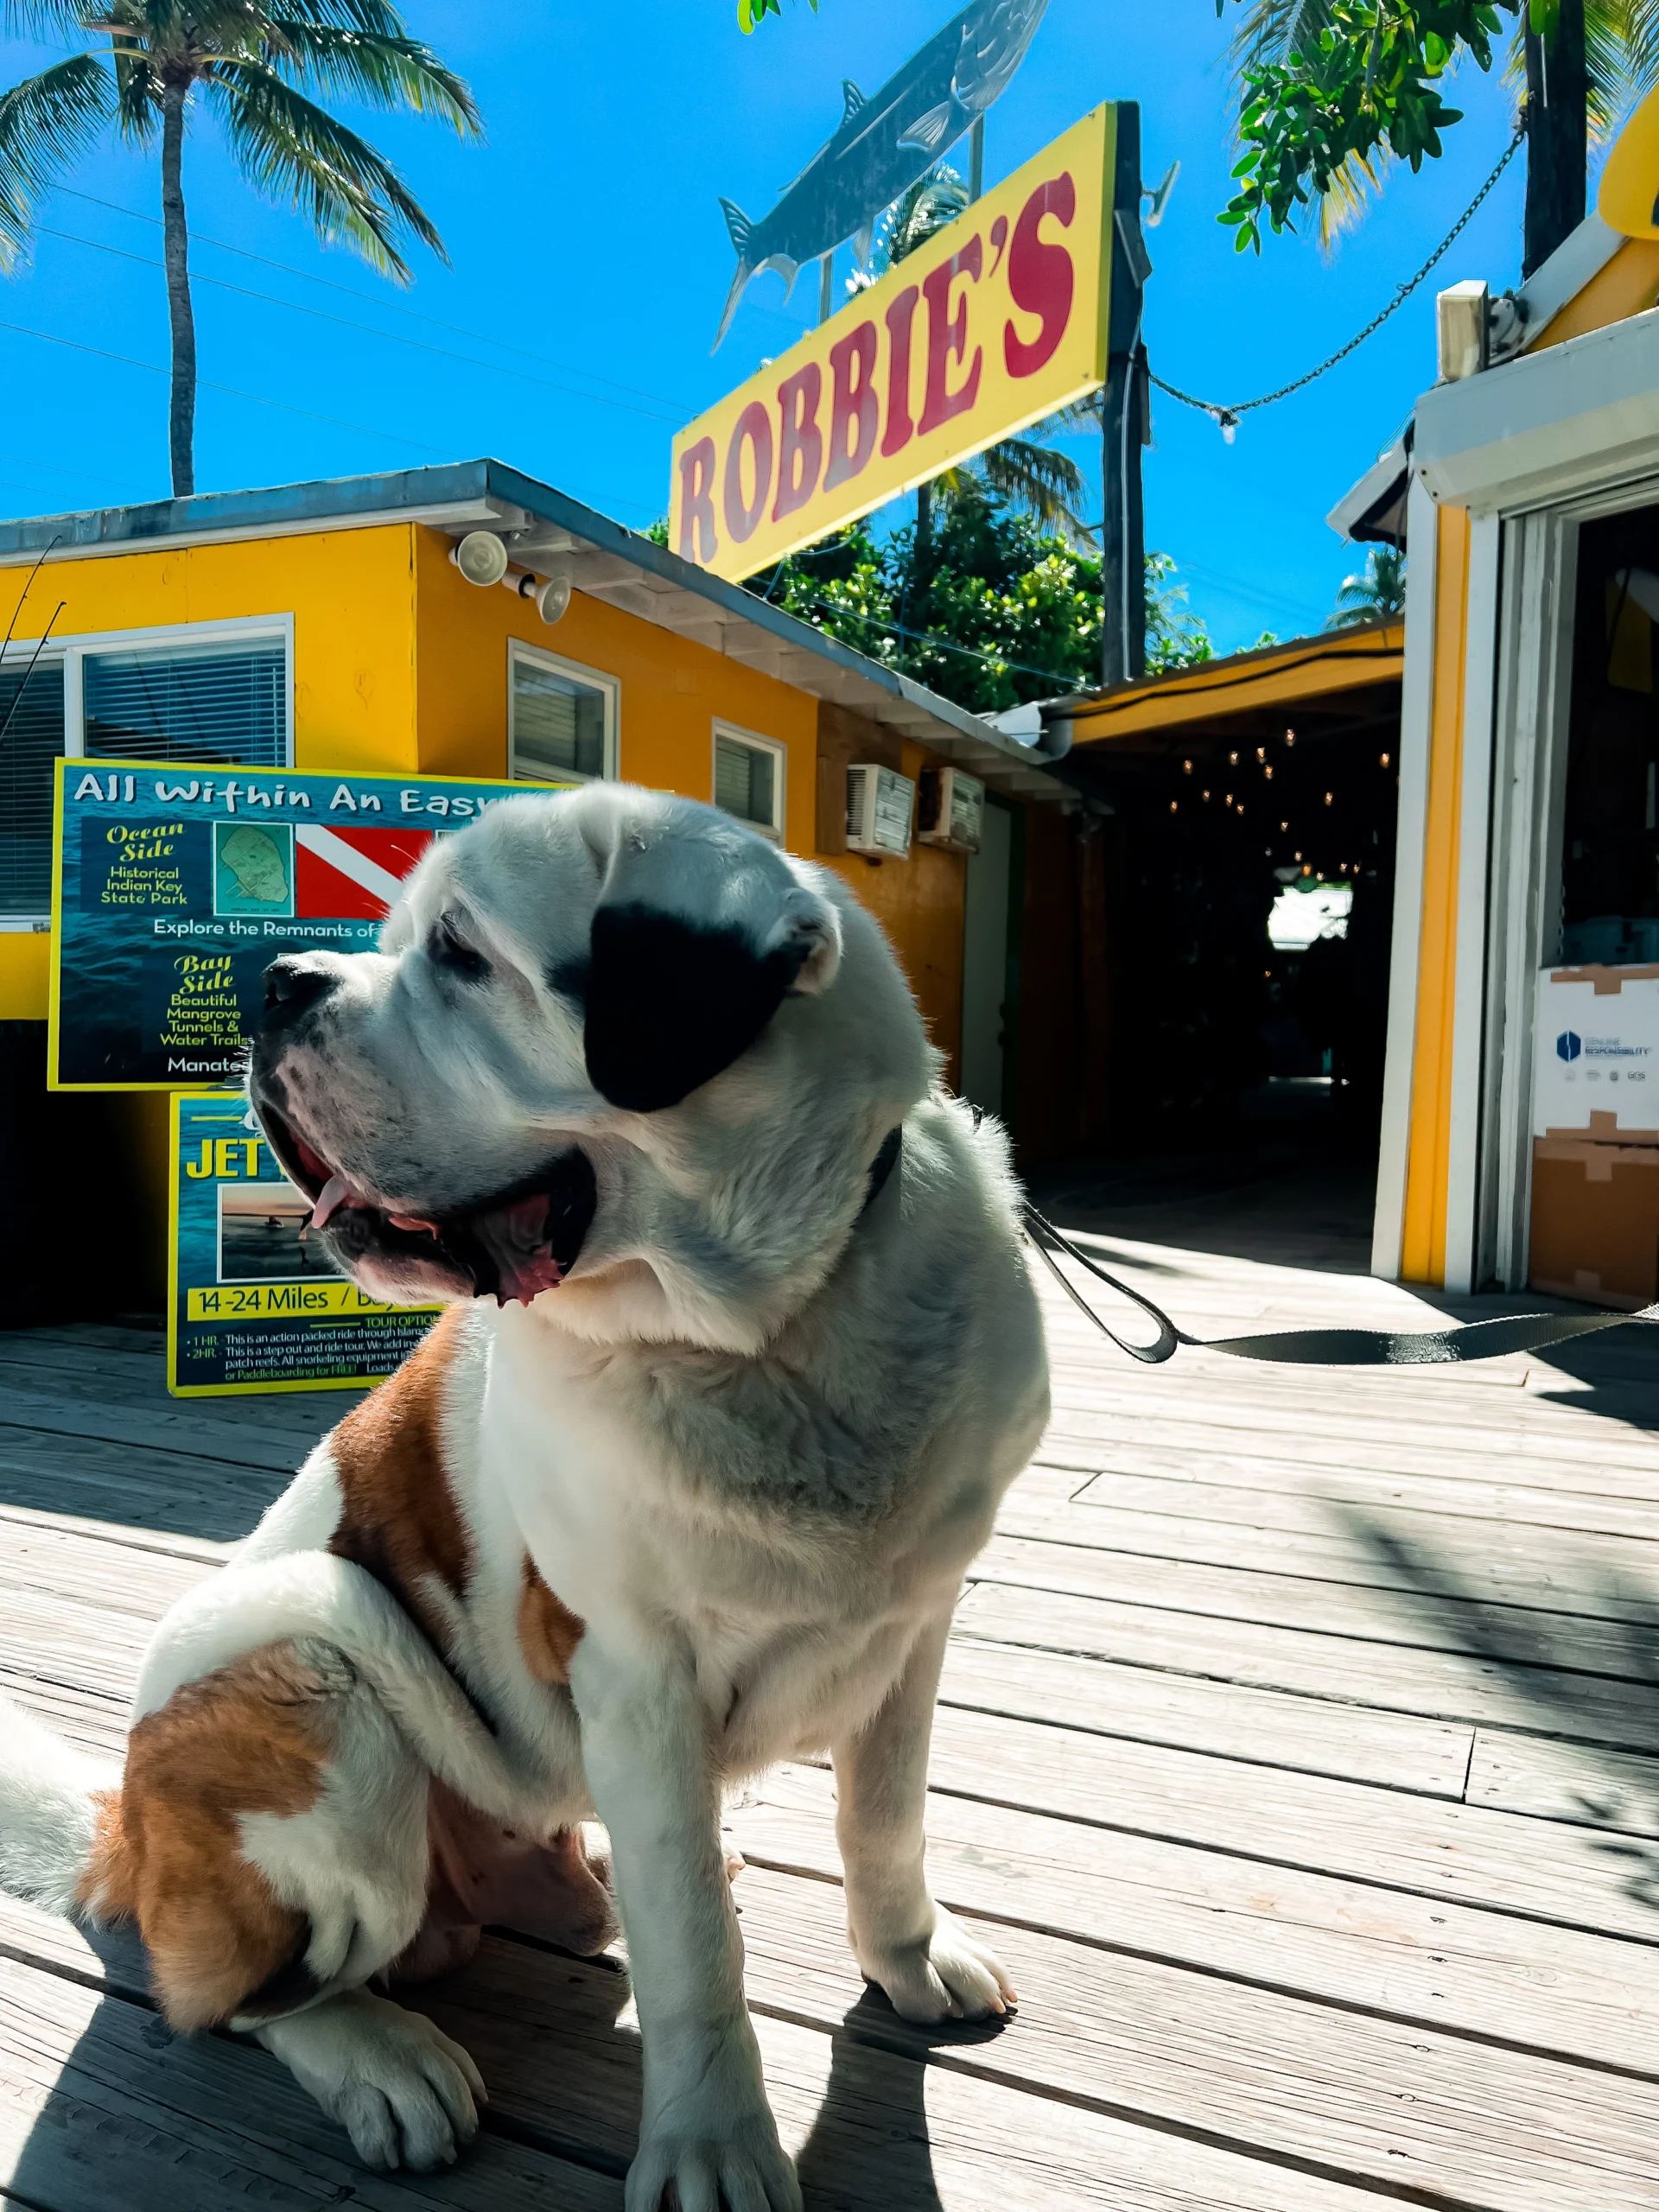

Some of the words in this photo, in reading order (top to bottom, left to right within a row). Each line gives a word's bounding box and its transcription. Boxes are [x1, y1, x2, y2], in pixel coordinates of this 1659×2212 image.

[679, 170, 1077, 563] ROBBIE'S
[73, 773, 135, 802] All
[155, 780, 310, 812] Within
[330, 785, 381, 810] An
[106, 823, 185, 844] Ocean
[119, 839, 175, 861] Side
[111, 866, 179, 879] Historical
[106, 879, 152, 891] Indian
[156, 880, 183, 894] Key
[101, 891, 146, 904] State
[151, 892, 188, 905] Park
[154, 918, 224, 938] Explore
[228, 920, 259, 935] the
[264, 921, 353, 938] Remnants
[357, 922, 377, 938] of
[175, 955, 232, 975] Bay
[179, 970, 234, 995] Side
[171, 994, 237, 1006] Beautiful
[167, 1007, 241, 1022] Mangrove
[168, 1020, 224, 1032] Tunnels
[226, 1020, 238, 1033] &
[160, 1033, 207, 1046] Water
[210, 1033, 249, 1046] Trails
[168, 1056, 239, 1072] Manate
[186, 1139, 265, 1179] JET
[198, 1290, 262, 1313] 14-24
[267, 1287, 328, 1311] Miles
[365, 1316, 397, 1328] TOUR
[226, 1333, 245, 1344] This
[246, 1333, 254, 1344] is
[256, 1333, 268, 1343] an
[270, 1332, 299, 1343] action
[302, 1329, 336, 1343] packed
[338, 1329, 356, 1339] ride
[358, 1327, 396, 1341] through
[226, 1346, 245, 1357] This
[247, 1346, 254, 1357] is
[255, 1347, 262, 1356] a
[264, 1345, 283, 1357] step
[286, 1344, 302, 1354] out
[304, 1342, 322, 1354] and
[325, 1341, 343, 1352] ride
[367, 1339, 382, 1351] We
[384, 1338, 402, 1349] add
[226, 1357, 253, 1370] patch
[282, 1354, 294, 1365] All
[296, 1352, 345, 1365] snorkeling
[346, 1351, 398, 1364] equipment
[238, 1365, 315, 1380] Paddleboarding
[316, 1365, 330, 1376] for
